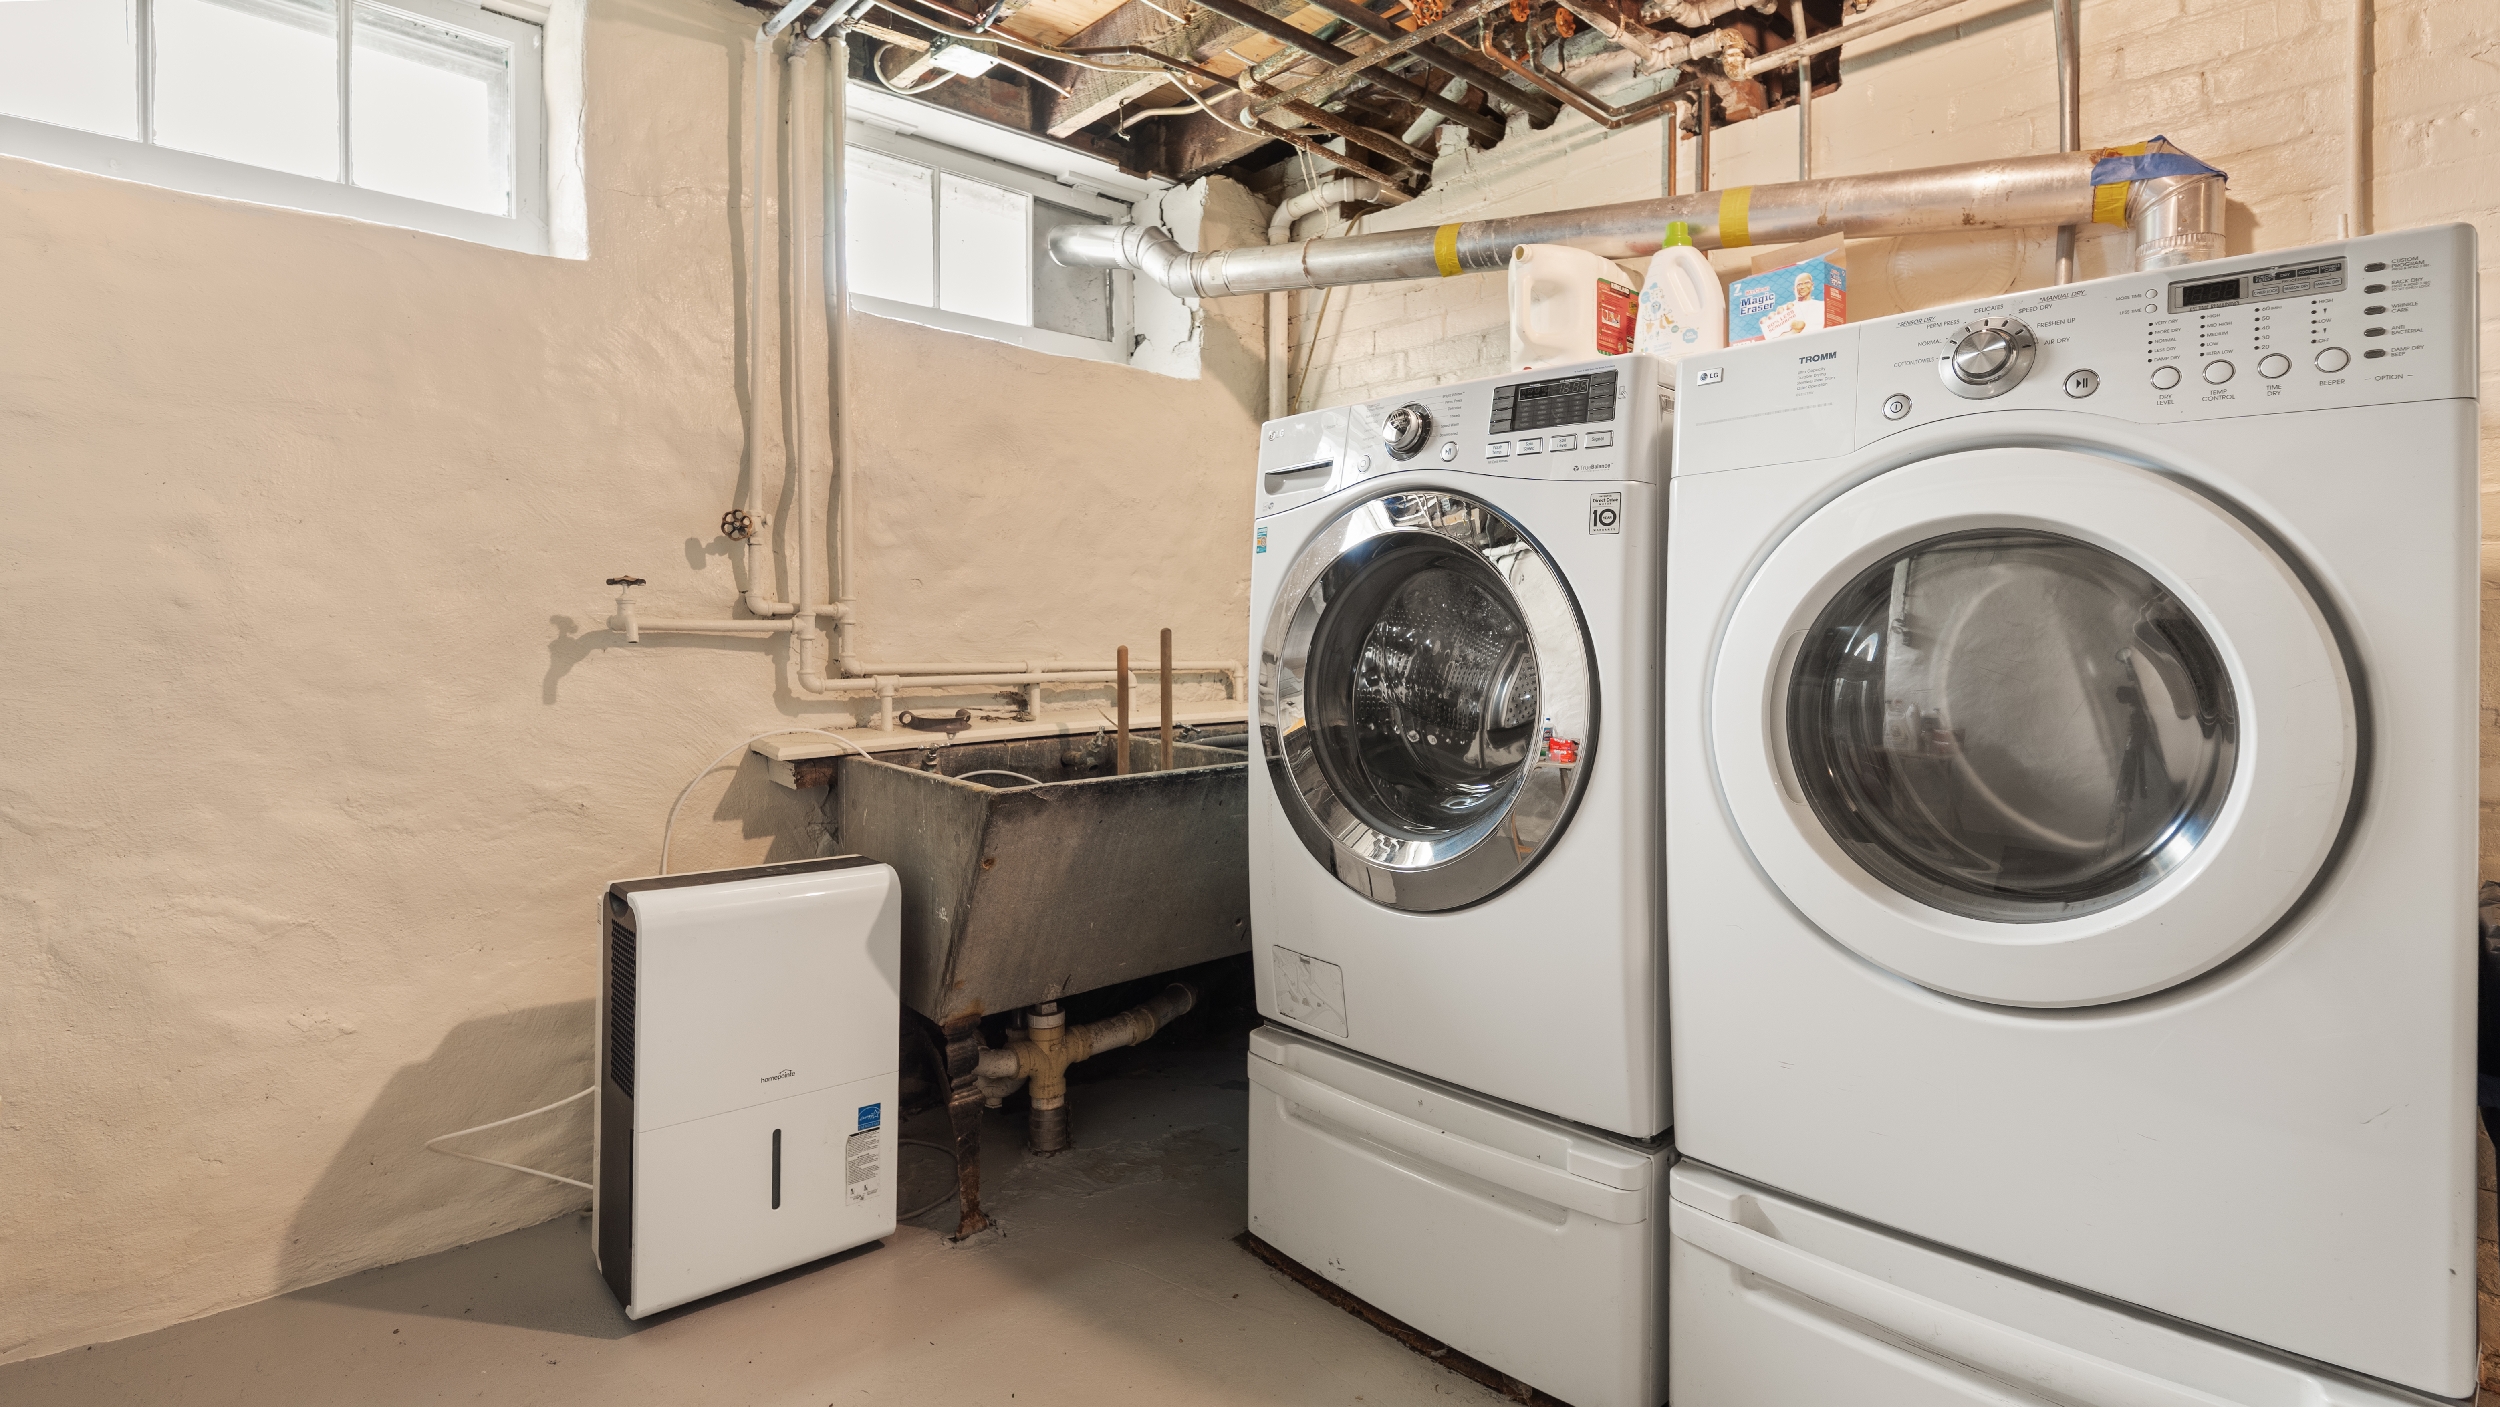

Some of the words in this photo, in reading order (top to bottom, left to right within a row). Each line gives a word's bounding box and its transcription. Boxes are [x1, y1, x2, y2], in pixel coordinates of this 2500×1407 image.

[2392, 256, 2419, 264] CUSTOM
[1733, 283, 1742, 294] 7
[2071, 290, 2086, 298] DRY
[1741, 292, 1774, 307] Magic
[1740, 302, 1774, 315] Eraser
[1974, 304, 2004, 314] DELICATES
[2018, 306, 2038, 314] SPEED
[1943, 319, 1960, 327] PRESS
[2036, 320, 2065, 328] FRESHEN
[1918, 339, 1942, 347] NORMAL
[2044, 338, 2055, 346] AIR
[2056, 336, 2071, 344] DRY
[1799, 351, 1838, 365] TROMM
[1592, 508, 1617, 527] 10
